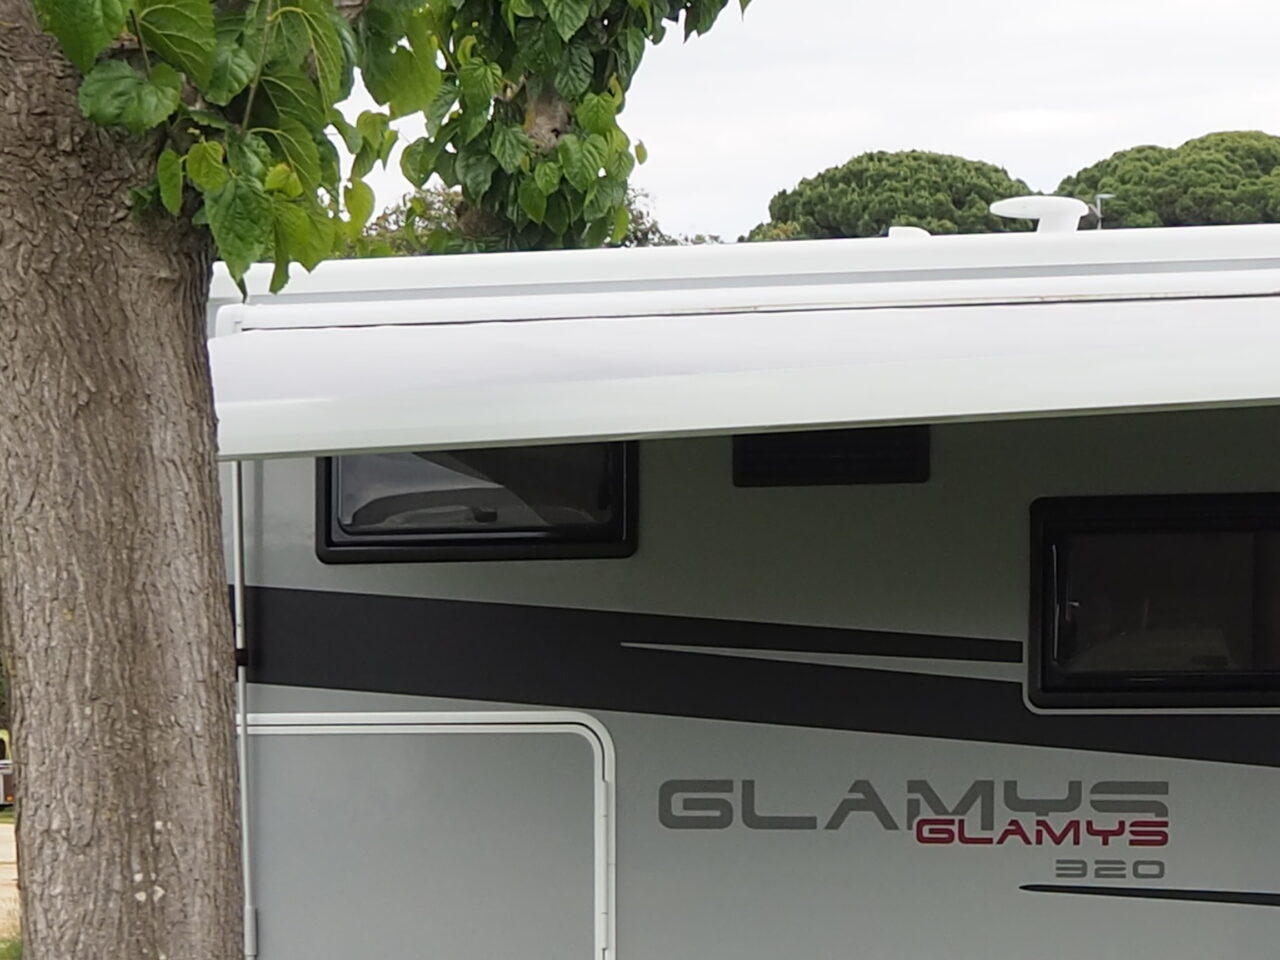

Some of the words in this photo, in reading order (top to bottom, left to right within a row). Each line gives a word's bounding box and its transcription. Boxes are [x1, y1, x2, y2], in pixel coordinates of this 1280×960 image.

[658, 779, 1169, 831] GLAMYS
[916, 818, 1169, 846] GLAMYS
[1055, 859, 1165, 879] 320
